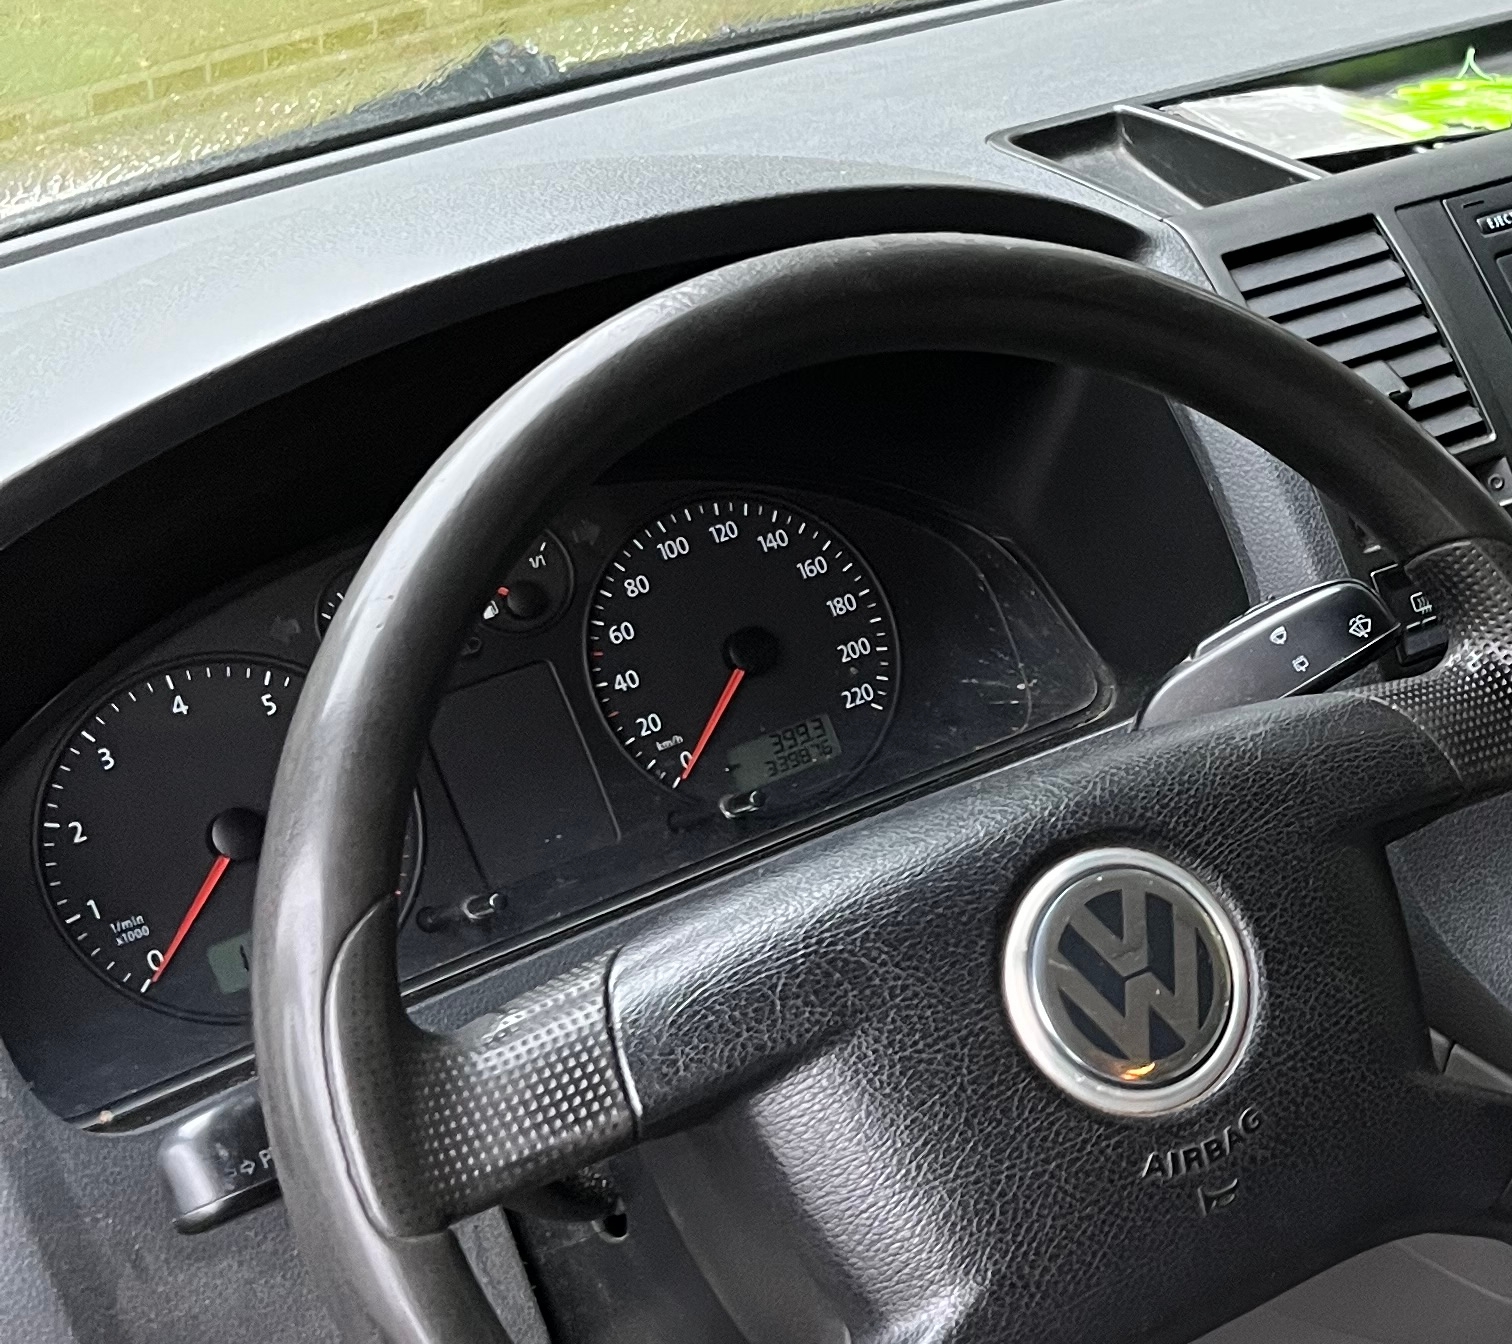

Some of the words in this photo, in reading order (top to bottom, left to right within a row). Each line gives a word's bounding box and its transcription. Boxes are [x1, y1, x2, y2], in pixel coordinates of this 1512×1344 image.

[708, 520, 739, 544] 120
[756, 528, 789, 553] 140
[656, 536, 690, 561] 100
[796, 555, 828, 580] 160
[623, 574, 650, 598] 80
[826, 593, 857, 617] 180
[608, 621, 635, 645] 60
[836, 637, 871, 663] 200
[613, 669, 640, 692] 40
[172, 695, 189, 715] 4
[261, 693, 277, 716] 5
[840, 683, 874, 709] 220
[635, 713, 662, 737] 20
[656, 734, 684, 752] km/h
[97, 747, 115, 770] 3
[68, 821, 88, 843] 2
[86, 899, 101, 920] 1
[110, 914, 145, 934] 1/min
[115, 924, 150, 946] x1000
[146, 949, 165, 971] 0
[1140, 1106, 1264, 1179] AIRBAG
